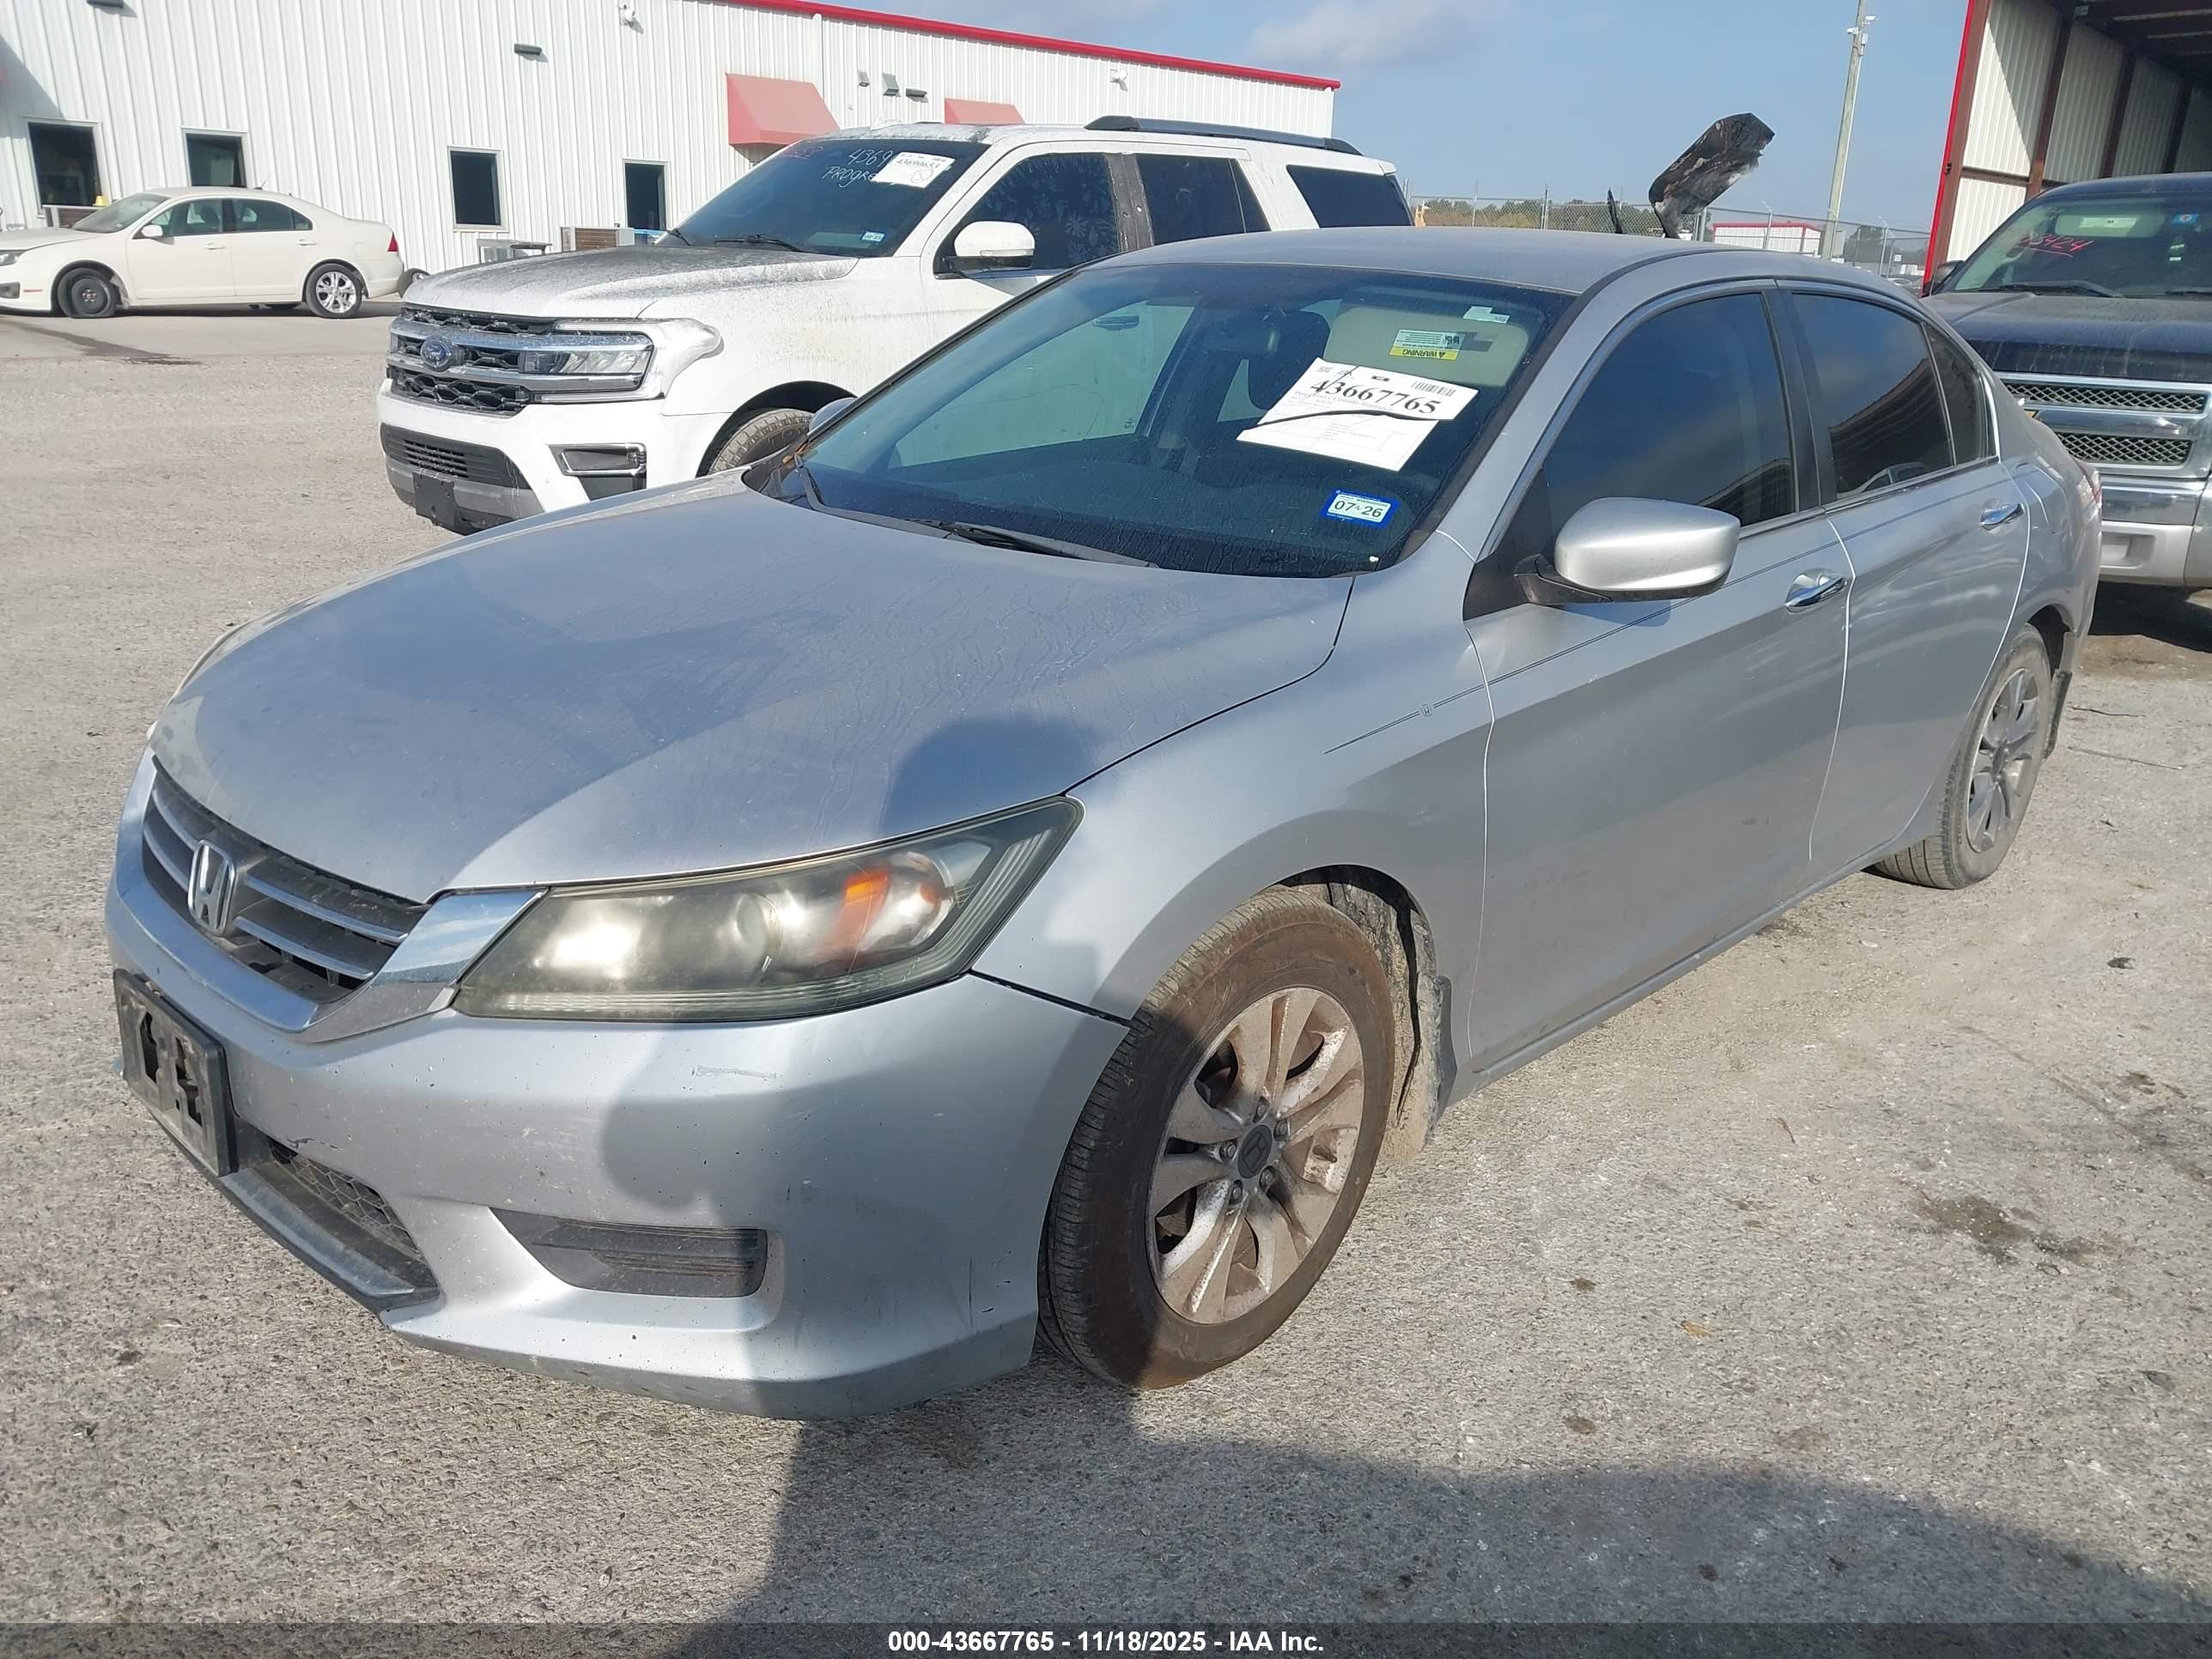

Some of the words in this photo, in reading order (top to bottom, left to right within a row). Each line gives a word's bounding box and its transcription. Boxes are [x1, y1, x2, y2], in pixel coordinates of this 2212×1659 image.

[1402, 349, 1437, 358] WARNING
[1310, 380, 1443, 415] 43667765
[1334, 500, 1357, 512] 07
[1361, 506, 1383, 518] 26
